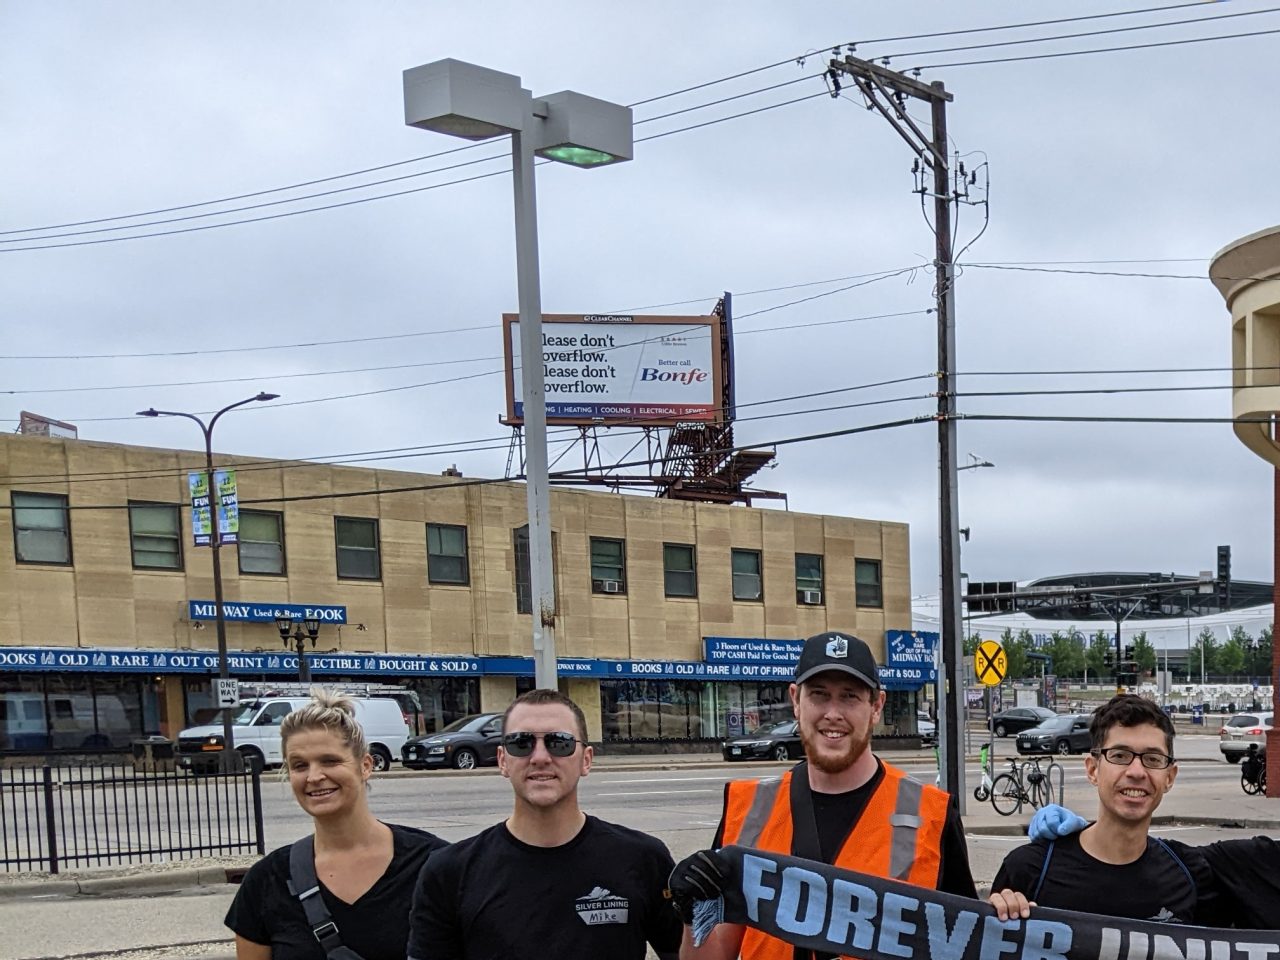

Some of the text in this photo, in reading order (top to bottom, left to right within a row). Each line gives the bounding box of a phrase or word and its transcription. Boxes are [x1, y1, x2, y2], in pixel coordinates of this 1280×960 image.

[542, 333, 614, 347] lease don't
[542, 350, 607, 362] overflow.
[543, 365, 616, 378] lease don't
[640, 367, 708, 385] Bonfe
[544, 381, 609, 393] overflow.
[600, 406, 631, 414] COOLING
[194, 496, 209, 507] FUN
[222, 495, 237, 505] FUN
[194, 604, 251, 617] MIWAY
[253, 609, 273, 617] Used
[285, 610, 302, 618] Rare
[721, 642, 740, 650] Floors
[748, 643, 763, 651] Used
[712, 651, 727, 659] TOP
[727, 651, 746, 659] CASH
[747, 652, 760, 660] Paid
[761, 652, 772, 660] For
[892, 653, 923, 662] MIDWAY
[0, 653, 469, 672] OOKS OLD RARE OUT OF PRINT COECTIBLE BOUGHT & SOLD
[576, 663, 592, 671] BOOK
[978, 657, 984, 668] R
[997, 657, 1004, 668] R
[631, 663, 921, 678] BOOKS OLD RARE OUT OF PRINT GHT & SOLD
[575, 901, 629, 911] SILVER LINING
[589, 912, 617, 923] Mike
